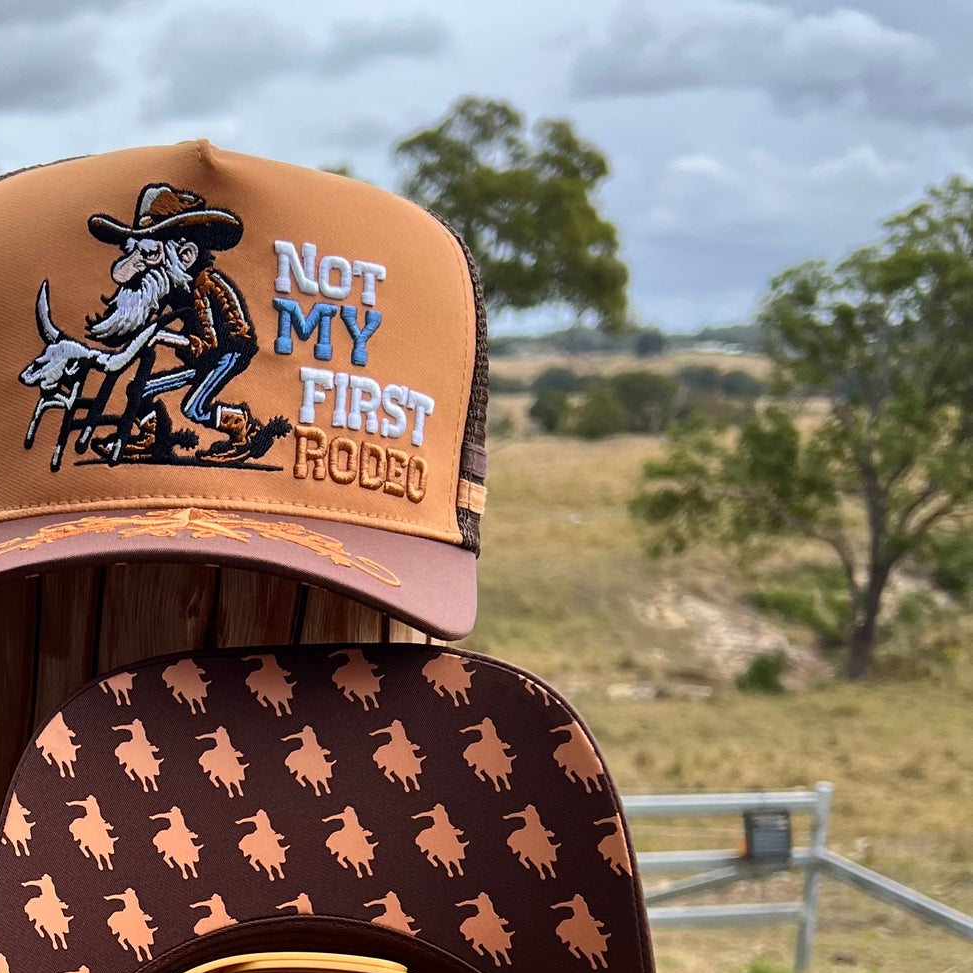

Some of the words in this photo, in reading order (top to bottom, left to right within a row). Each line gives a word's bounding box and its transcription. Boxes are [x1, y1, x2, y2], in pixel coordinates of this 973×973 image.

[274, 239, 386, 306] NOT
[273, 297, 382, 366] MY
[299, 366, 435, 446] FIRST
[293, 425, 428, 504] RODEO
